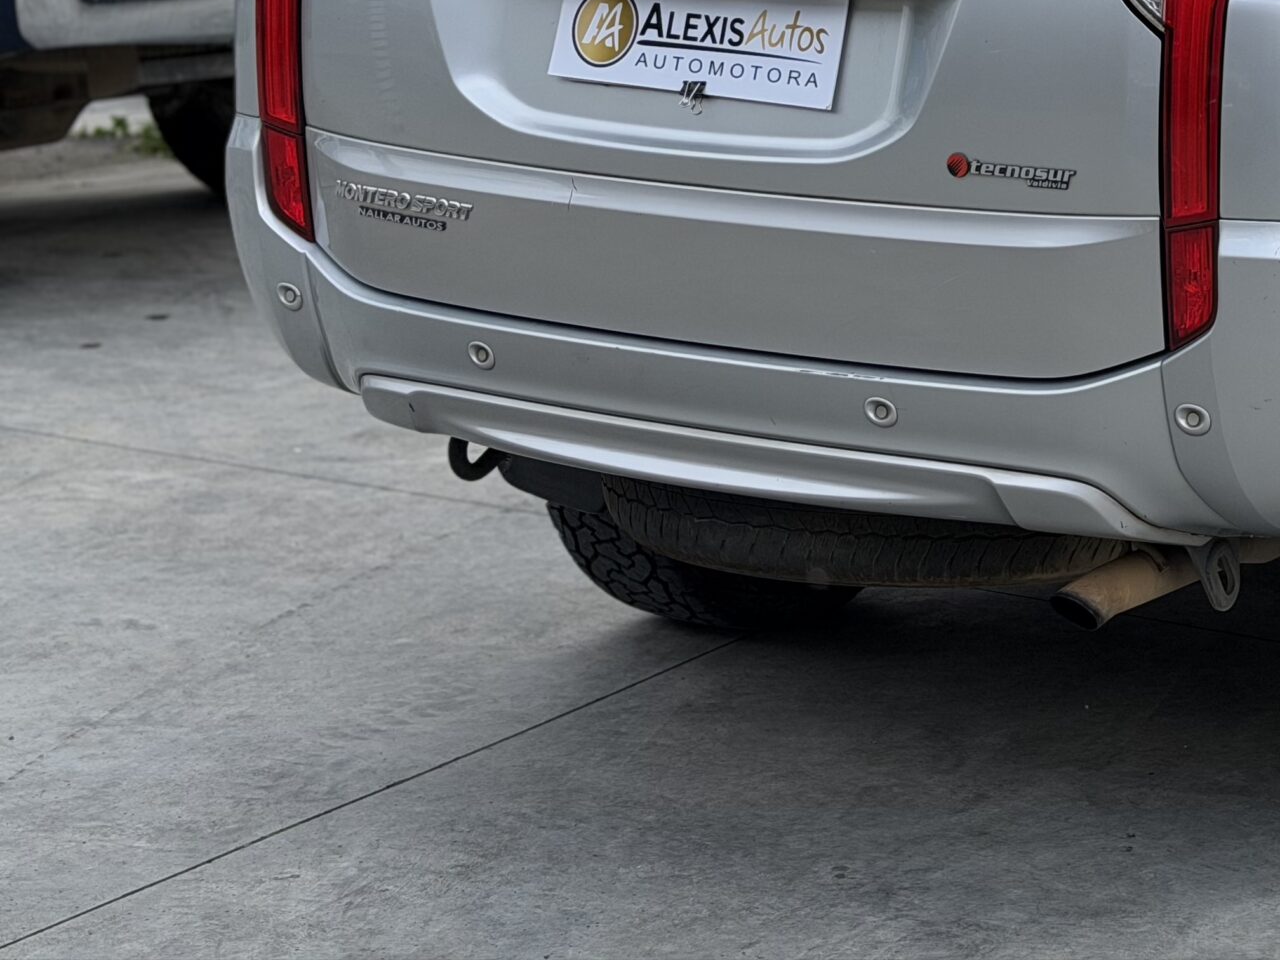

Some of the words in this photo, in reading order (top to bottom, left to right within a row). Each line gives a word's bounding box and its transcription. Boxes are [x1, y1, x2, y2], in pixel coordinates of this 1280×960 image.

[635, 52, 819, 88] AUTOMOTORA
[969, 159, 1077, 182] tecnosur
[335, 179, 411, 210] MONTERO
[410, 194, 474, 221] SPORT
[358, 206, 401, 224] NALLAR
[402, 216, 445, 232] AUTOS
